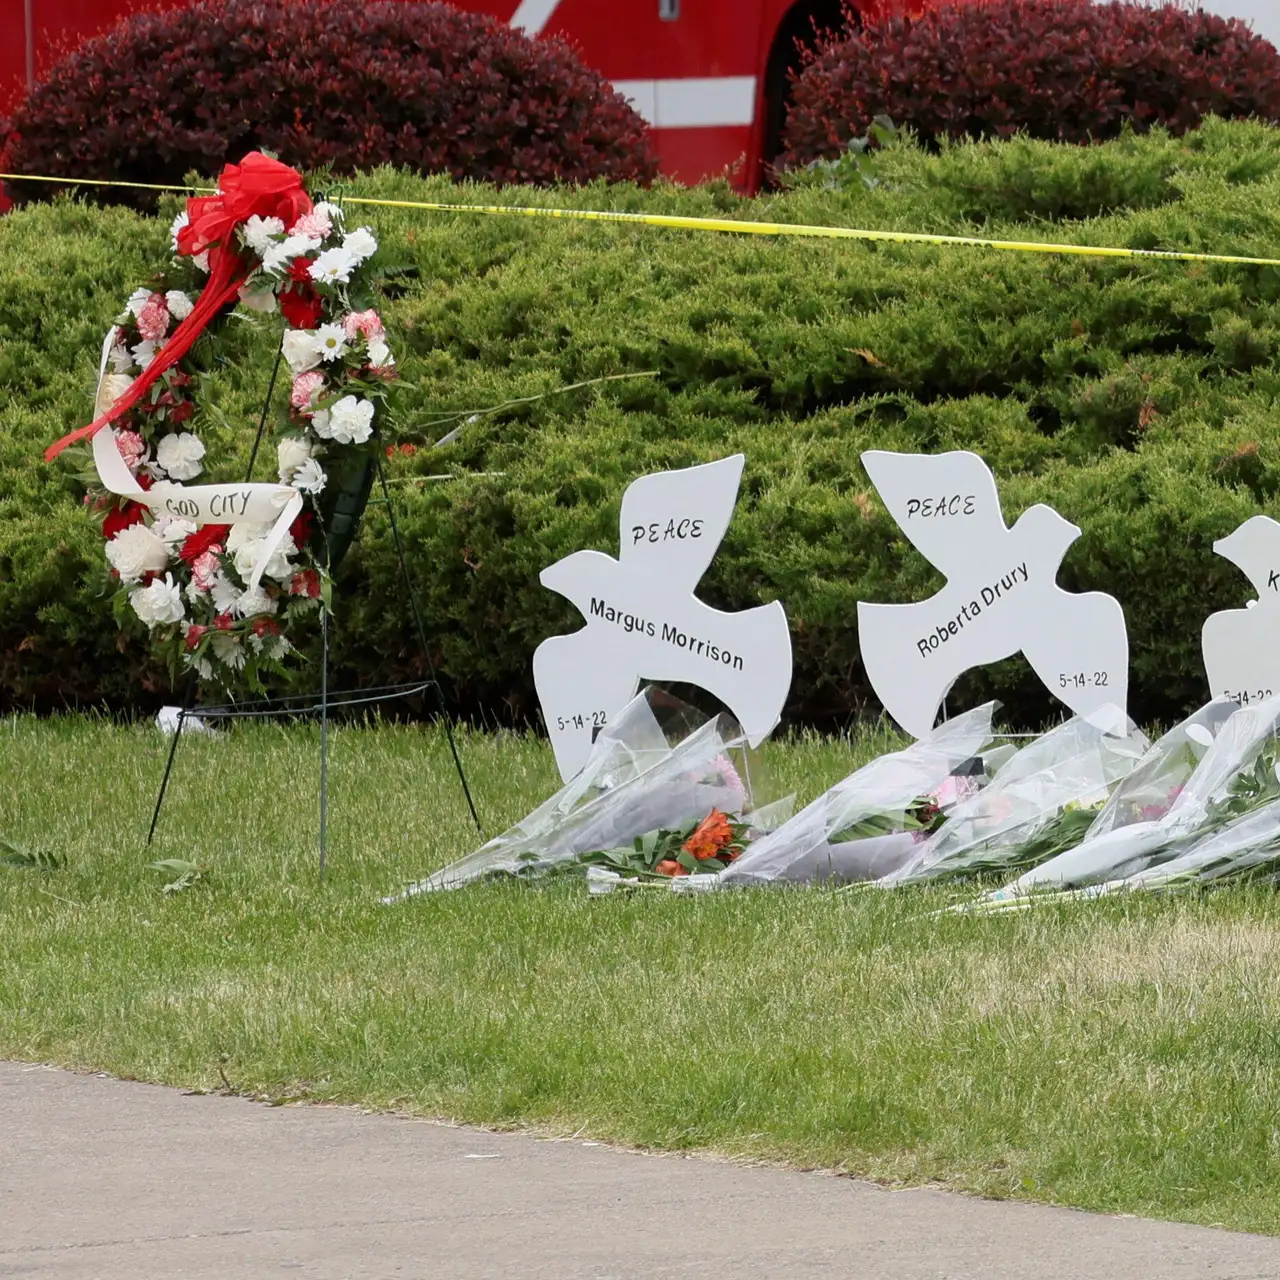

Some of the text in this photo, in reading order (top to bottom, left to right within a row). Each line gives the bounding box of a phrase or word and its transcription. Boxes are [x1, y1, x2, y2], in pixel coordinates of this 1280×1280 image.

[209, 490, 252, 517] CITY
[906, 494, 975, 519] PEACE
[631, 518, 704, 545] PEACE
[916, 562, 1029, 658] Roberta Drury
[590, 597, 743, 671] Margus Morrison
[1059, 671, 1108, 688] 5-14-22
[557, 710, 608, 731] 5-14-22
